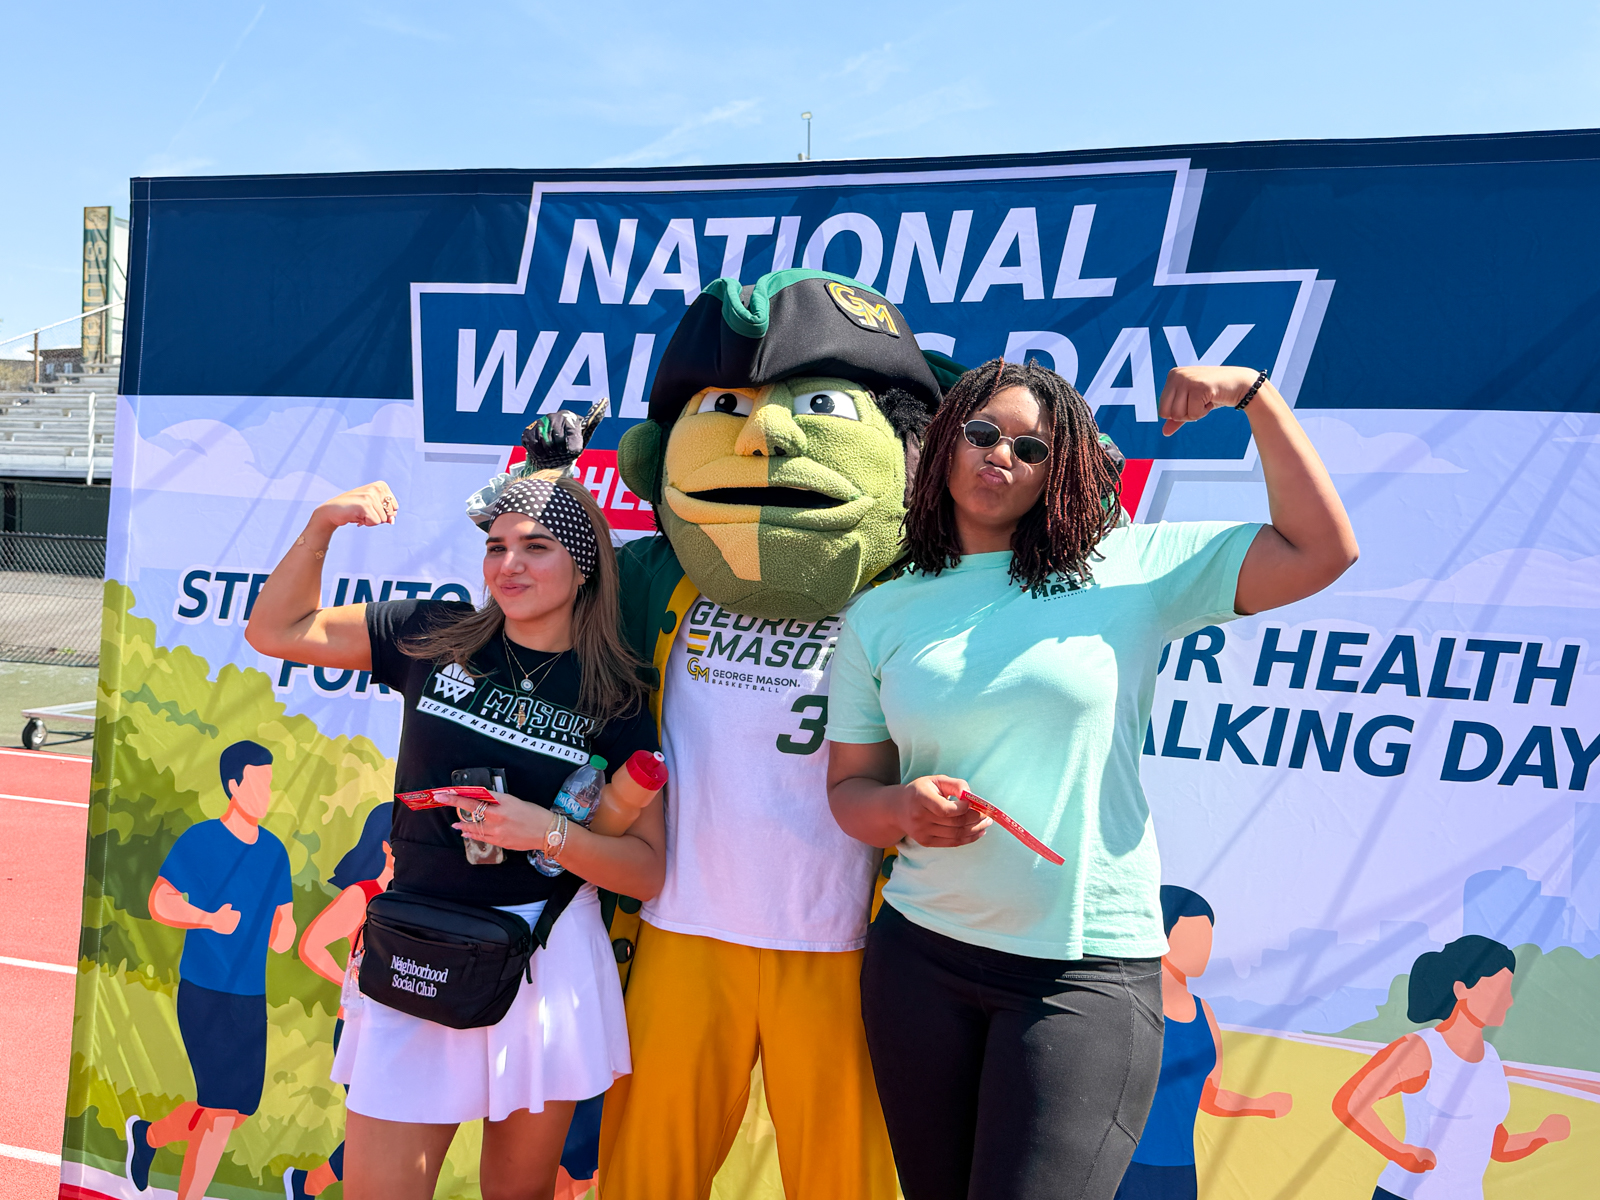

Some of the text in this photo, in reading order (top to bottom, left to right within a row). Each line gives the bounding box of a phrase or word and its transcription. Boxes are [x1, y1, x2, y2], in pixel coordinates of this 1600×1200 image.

[558, 203, 1117, 306] NATIONAL
[828, 282, 899, 335] GM
[690, 601, 841, 640] GEORGE
[687, 657, 710, 683] GM
[712, 678, 780, 693] BASKETBALL
[713, 669, 753, 683] GEORGE
[1252, 627, 1580, 707] HEALTH
[421, 700, 585, 762] GEORGE MASON PATRIOTS
[485, 688, 596, 740] MASON
[1143, 699, 1600, 791] LKING DAY
[390, 954, 449, 983] Neighborhood
[391, 974, 437, 998] Social Club
